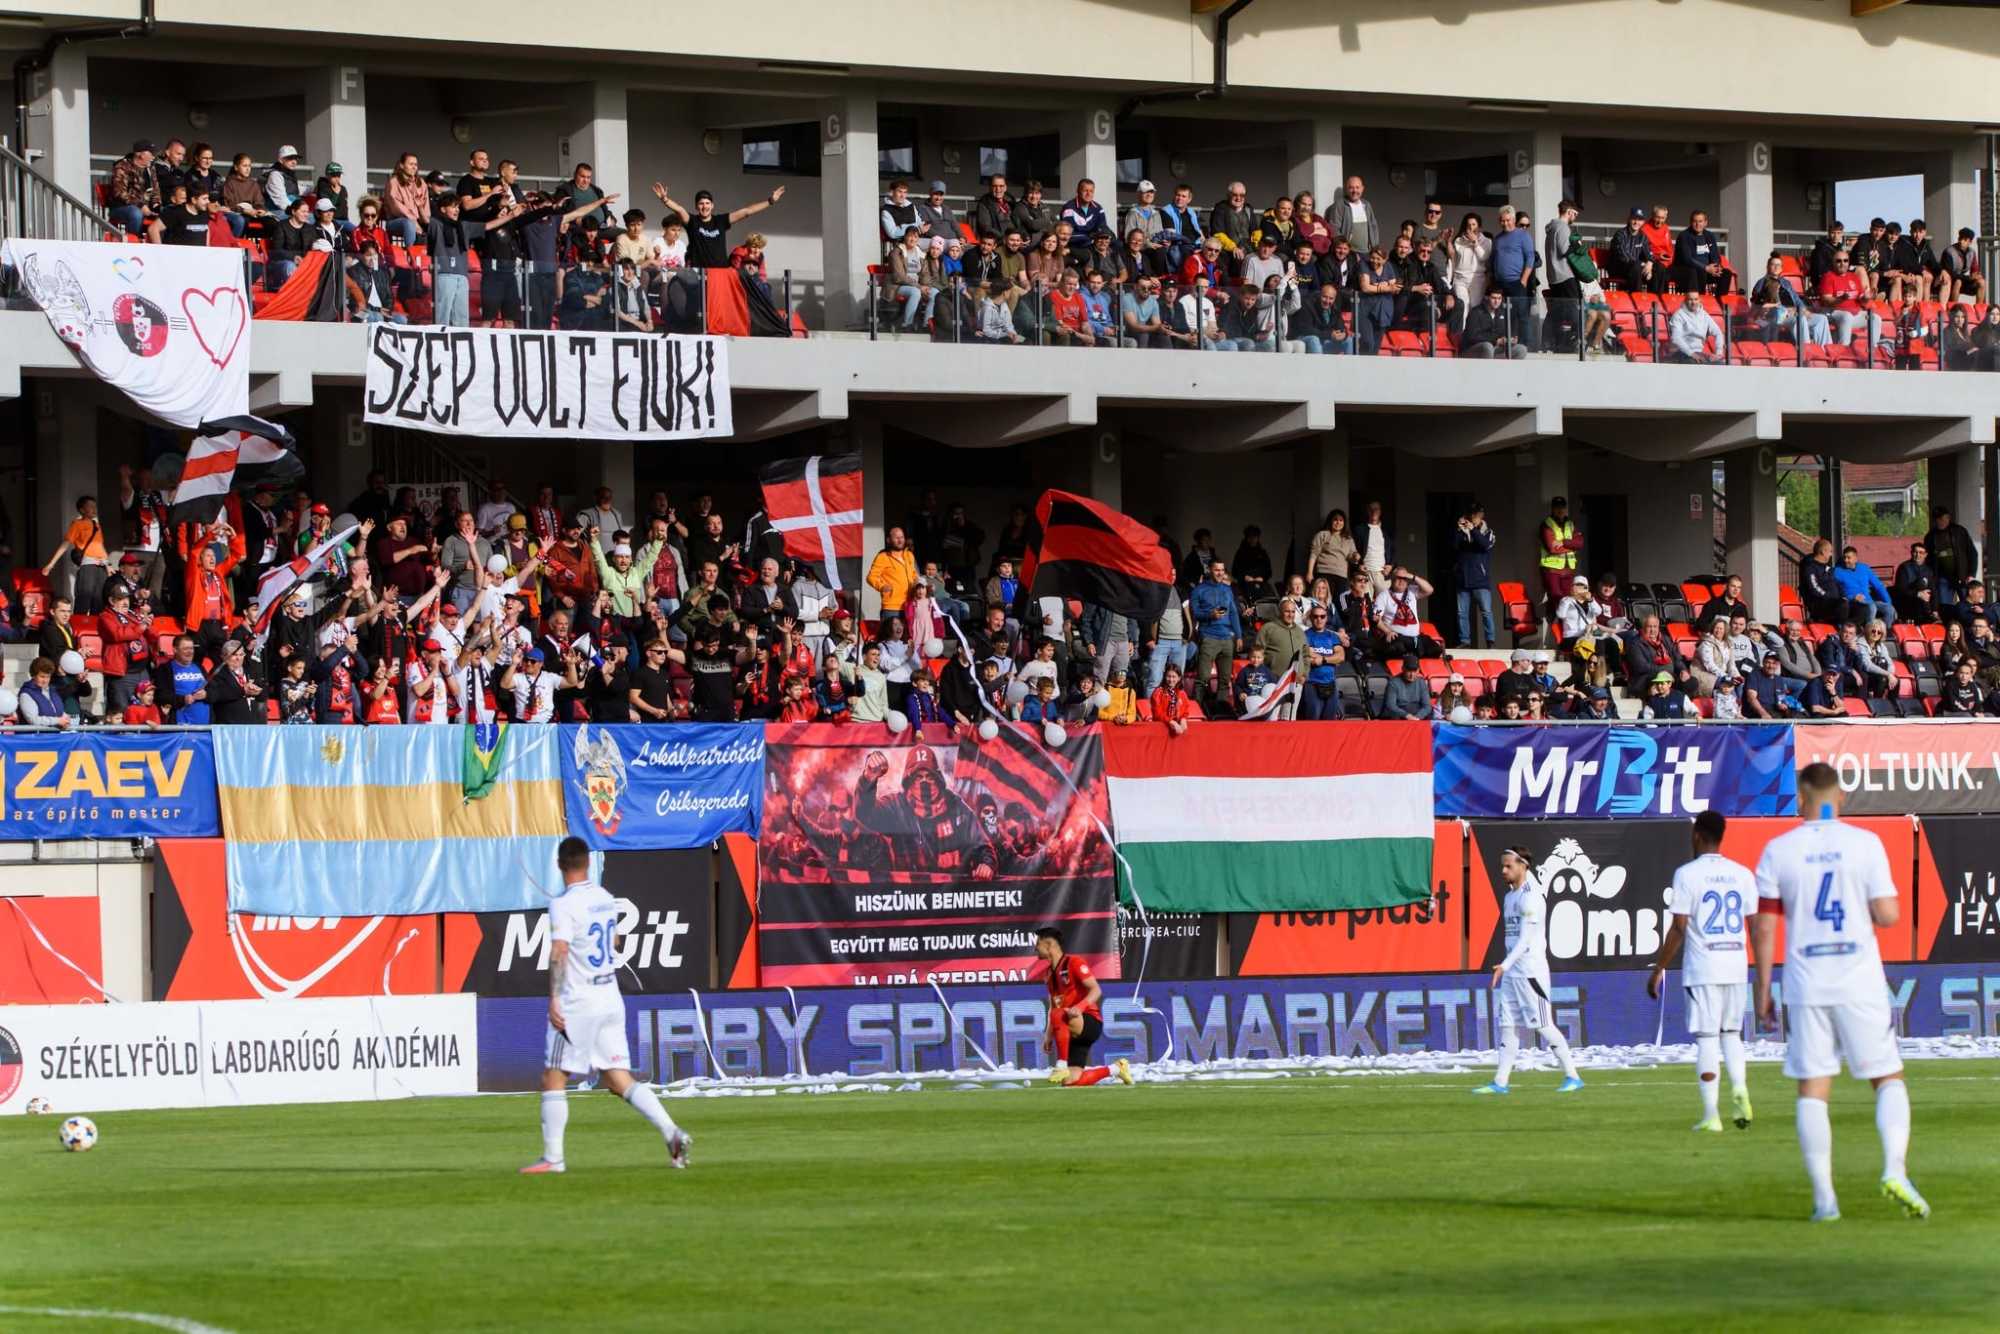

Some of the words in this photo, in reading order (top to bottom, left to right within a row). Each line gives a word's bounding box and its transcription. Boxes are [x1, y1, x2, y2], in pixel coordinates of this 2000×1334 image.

[341, 67, 358, 100] F
[827, 114, 840, 138] G
[1093, 109, 1111, 140] G
[1514, 150, 1529, 172] G
[1752, 142, 1768, 171] G
[368, 326, 476, 426] SZÉP
[490, 334, 597, 428] VOLT
[612, 330, 715, 432] FIÚK!
[347, 413, 366, 447] B
[1100, 432, 1115, 463] C
[1759, 447, 1772, 475] C
[15, 750, 194, 799] ZAEV
[1504, 730, 1712, 813] MrBit
[14, 812, 34, 821] az
[112, 808, 181, 820] mester
[855, 891, 927, 912] HISZÜNK
[932, 890, 1022, 910] BENNETEK!
[1703, 890, 1743, 934] 28
[1814, 872, 1844, 931] 4
[497, 898, 690, 973] MBit
[587, 919, 617, 968] 30
[830, 936, 885, 954] EGYÜTT
[889, 937, 919, 952] MEG
[924, 933, 976, 950] TUDJUK
[979, 930, 1038, 948] CSINÁLN
[847, 997, 1151, 1078] SPORS
[1172, 987, 1583, 1062] MARKETIG
[40, 1036, 198, 1080] SZÉKELYFÖLD
[212, 1029, 340, 1074] LABDARÚGÓ
[352, 1026, 461, 1070] AKADÉMIA
